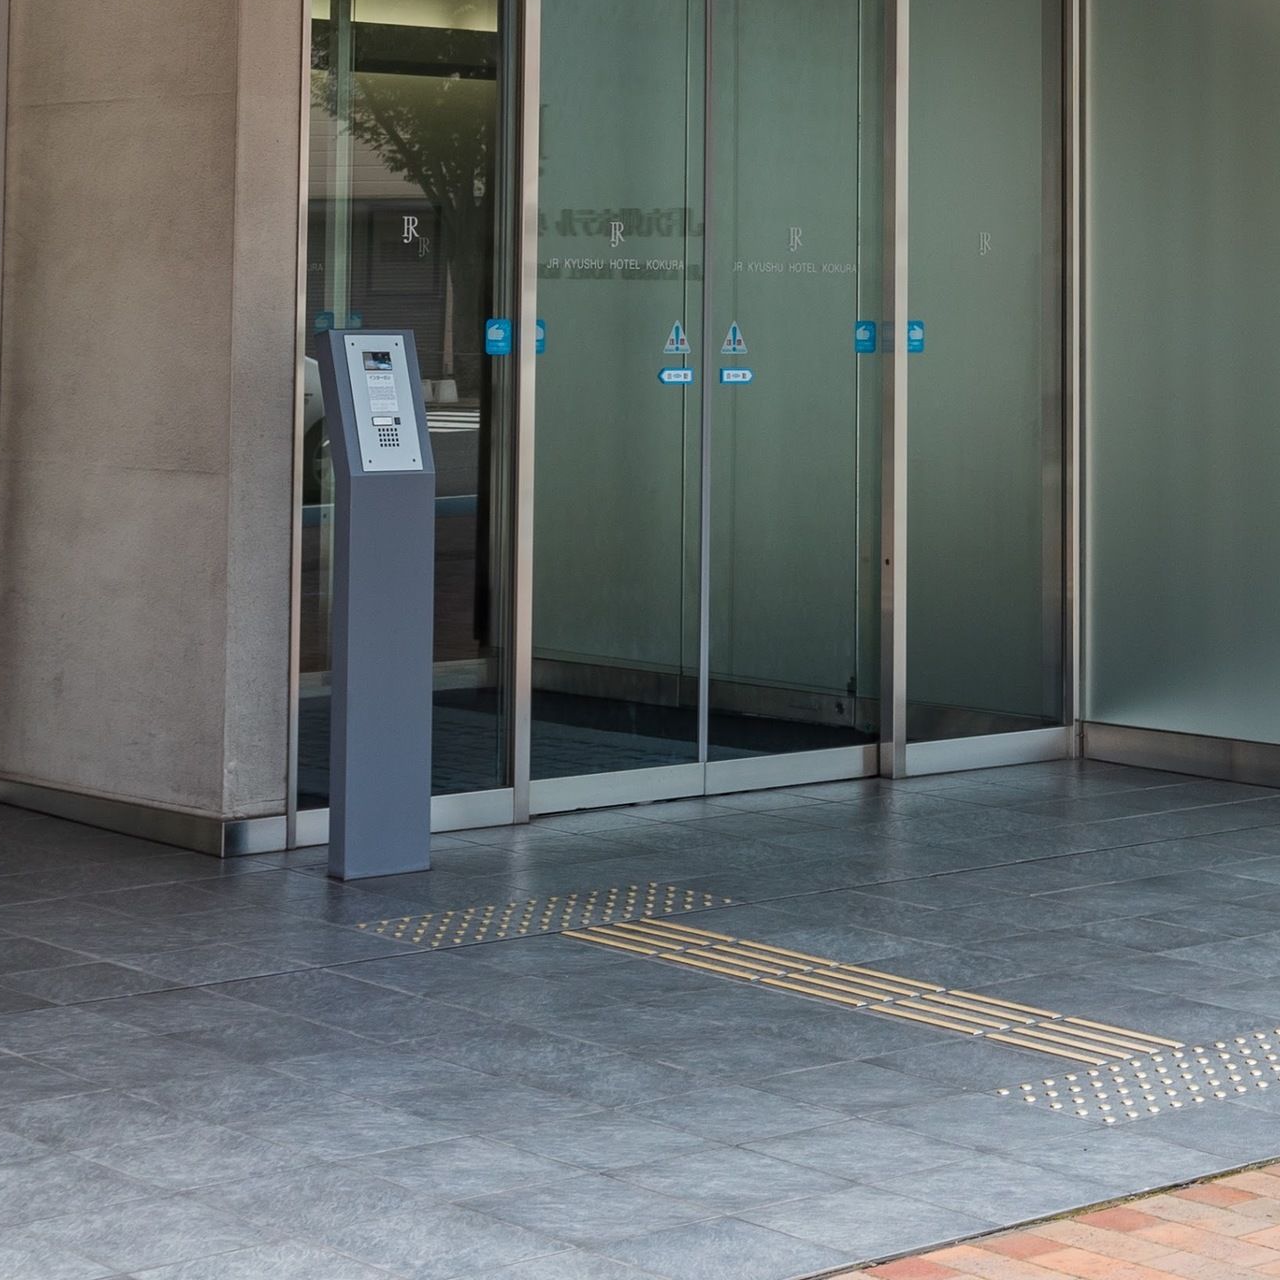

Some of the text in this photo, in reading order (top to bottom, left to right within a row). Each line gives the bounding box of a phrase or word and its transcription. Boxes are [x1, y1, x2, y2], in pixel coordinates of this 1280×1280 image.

[546, 258, 684, 270] JR KYUSHU HOTEL KOKURA
[748, 262, 784, 272] KYUSHU
[789, 262, 817, 273] HOTEL
[822, 262, 857, 273] KOKURA
